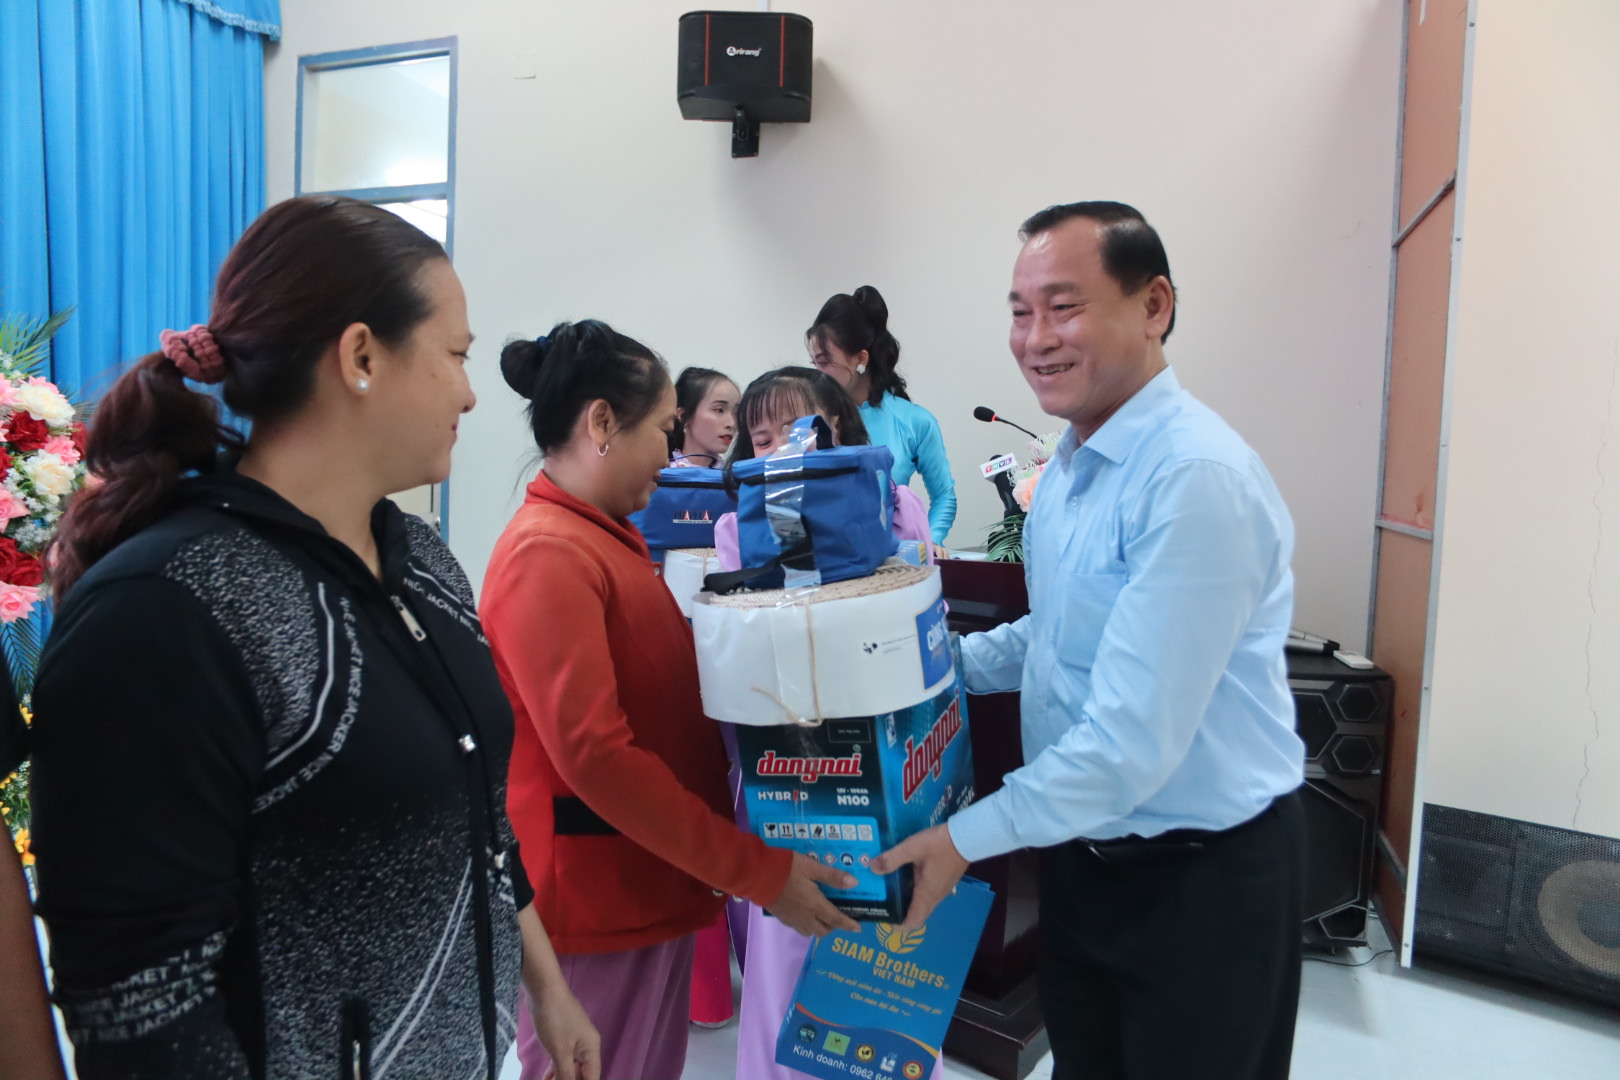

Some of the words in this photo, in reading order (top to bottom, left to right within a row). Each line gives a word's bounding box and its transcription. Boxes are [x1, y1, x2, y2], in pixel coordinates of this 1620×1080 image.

[726, 46, 759, 57] Arirang
[836, 795, 870, 807] N100
[831, 937, 875, 963] SIAM
[874, 951, 945, 989] Brothers
[872, 966, 894, 980] VIET
[893, 974, 916, 989] NAM
[793, 1044, 814, 1060] Kinh
[816, 1053, 848, 1072] doanh:
[850, 1064, 873, 1080] 0962
